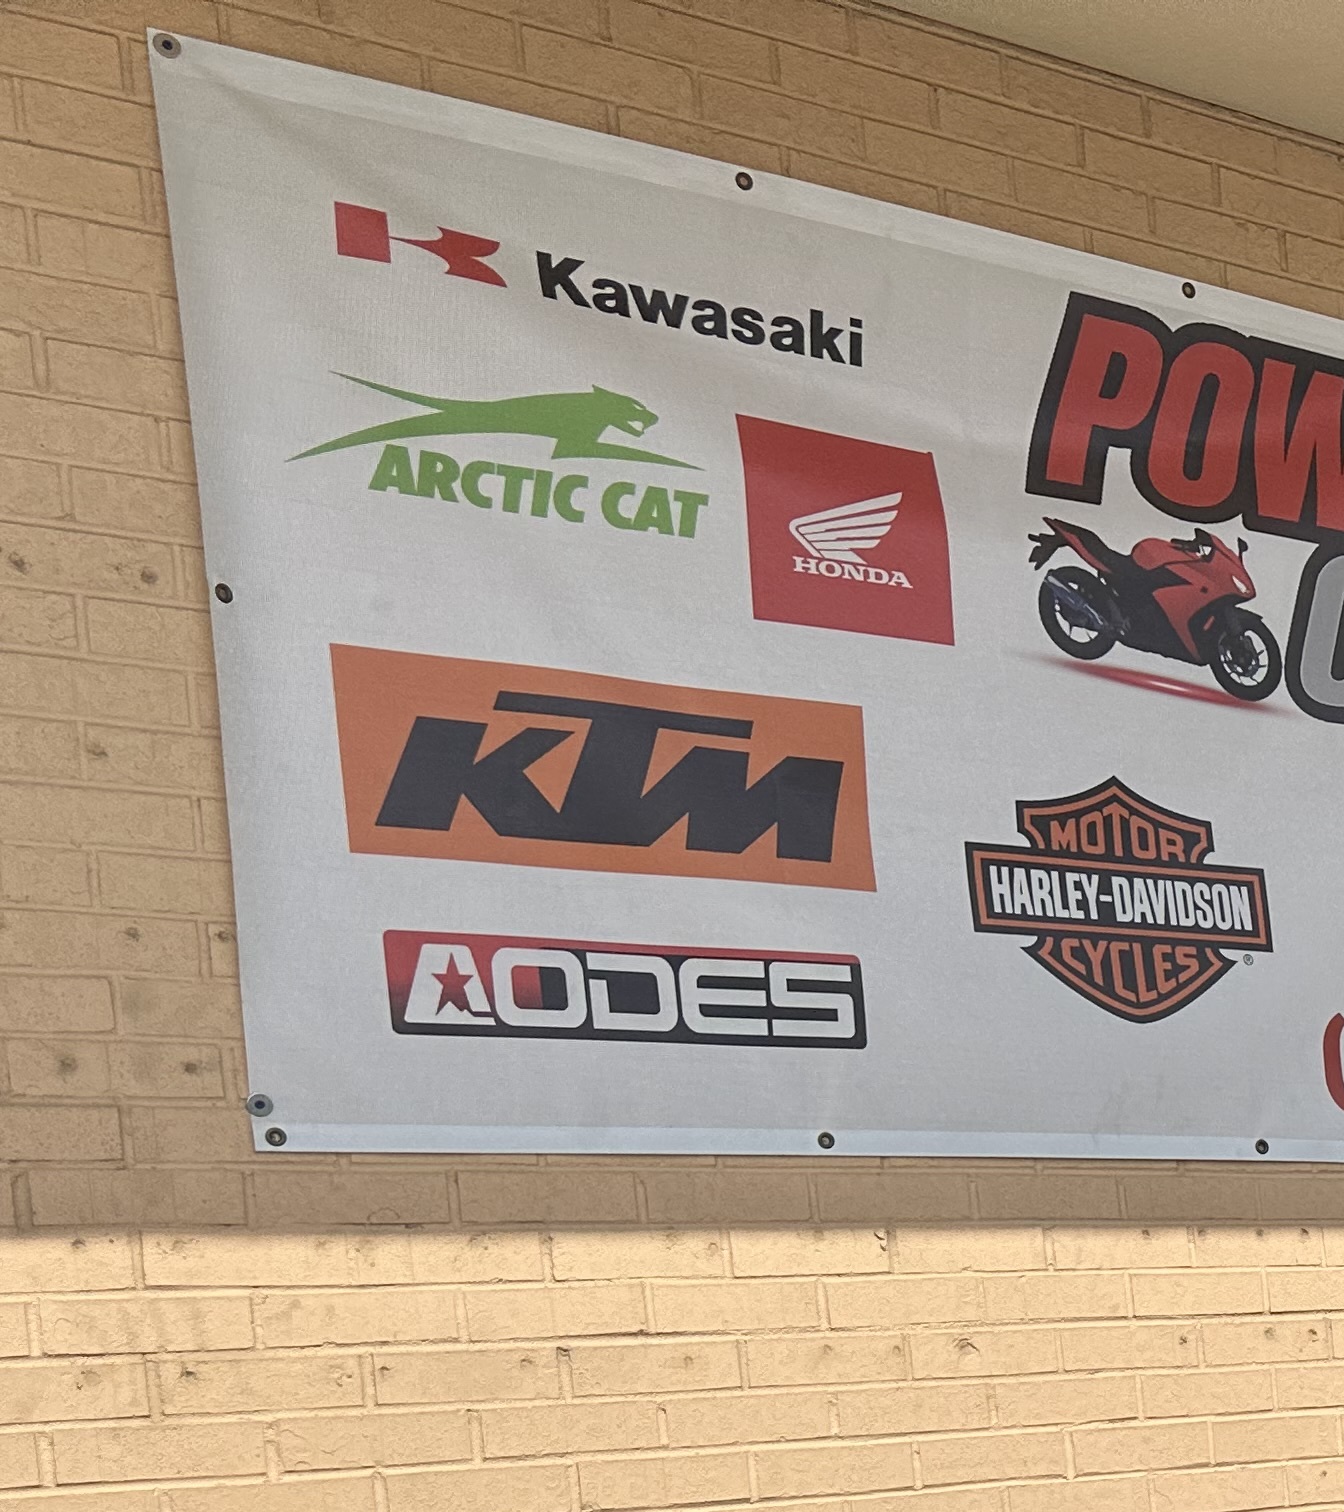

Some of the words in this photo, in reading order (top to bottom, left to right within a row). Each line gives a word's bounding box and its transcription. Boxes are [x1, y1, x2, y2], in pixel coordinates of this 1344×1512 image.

[535, 250, 864, 368] Kawasaki
[368, 444, 589, 523] ARCTIC
[600, 481, 709, 539] CAT
[792, 555, 914, 589] HONDA
[374, 690, 845, 862] KTM
[1050, 801, 1185, 863] MOTOR
[988, 865, 1253, 931] HARLEY-DAVIDSON
[403, 942, 855, 1037] AODES
[1060, 938, 1200, 1003] CYCLES
